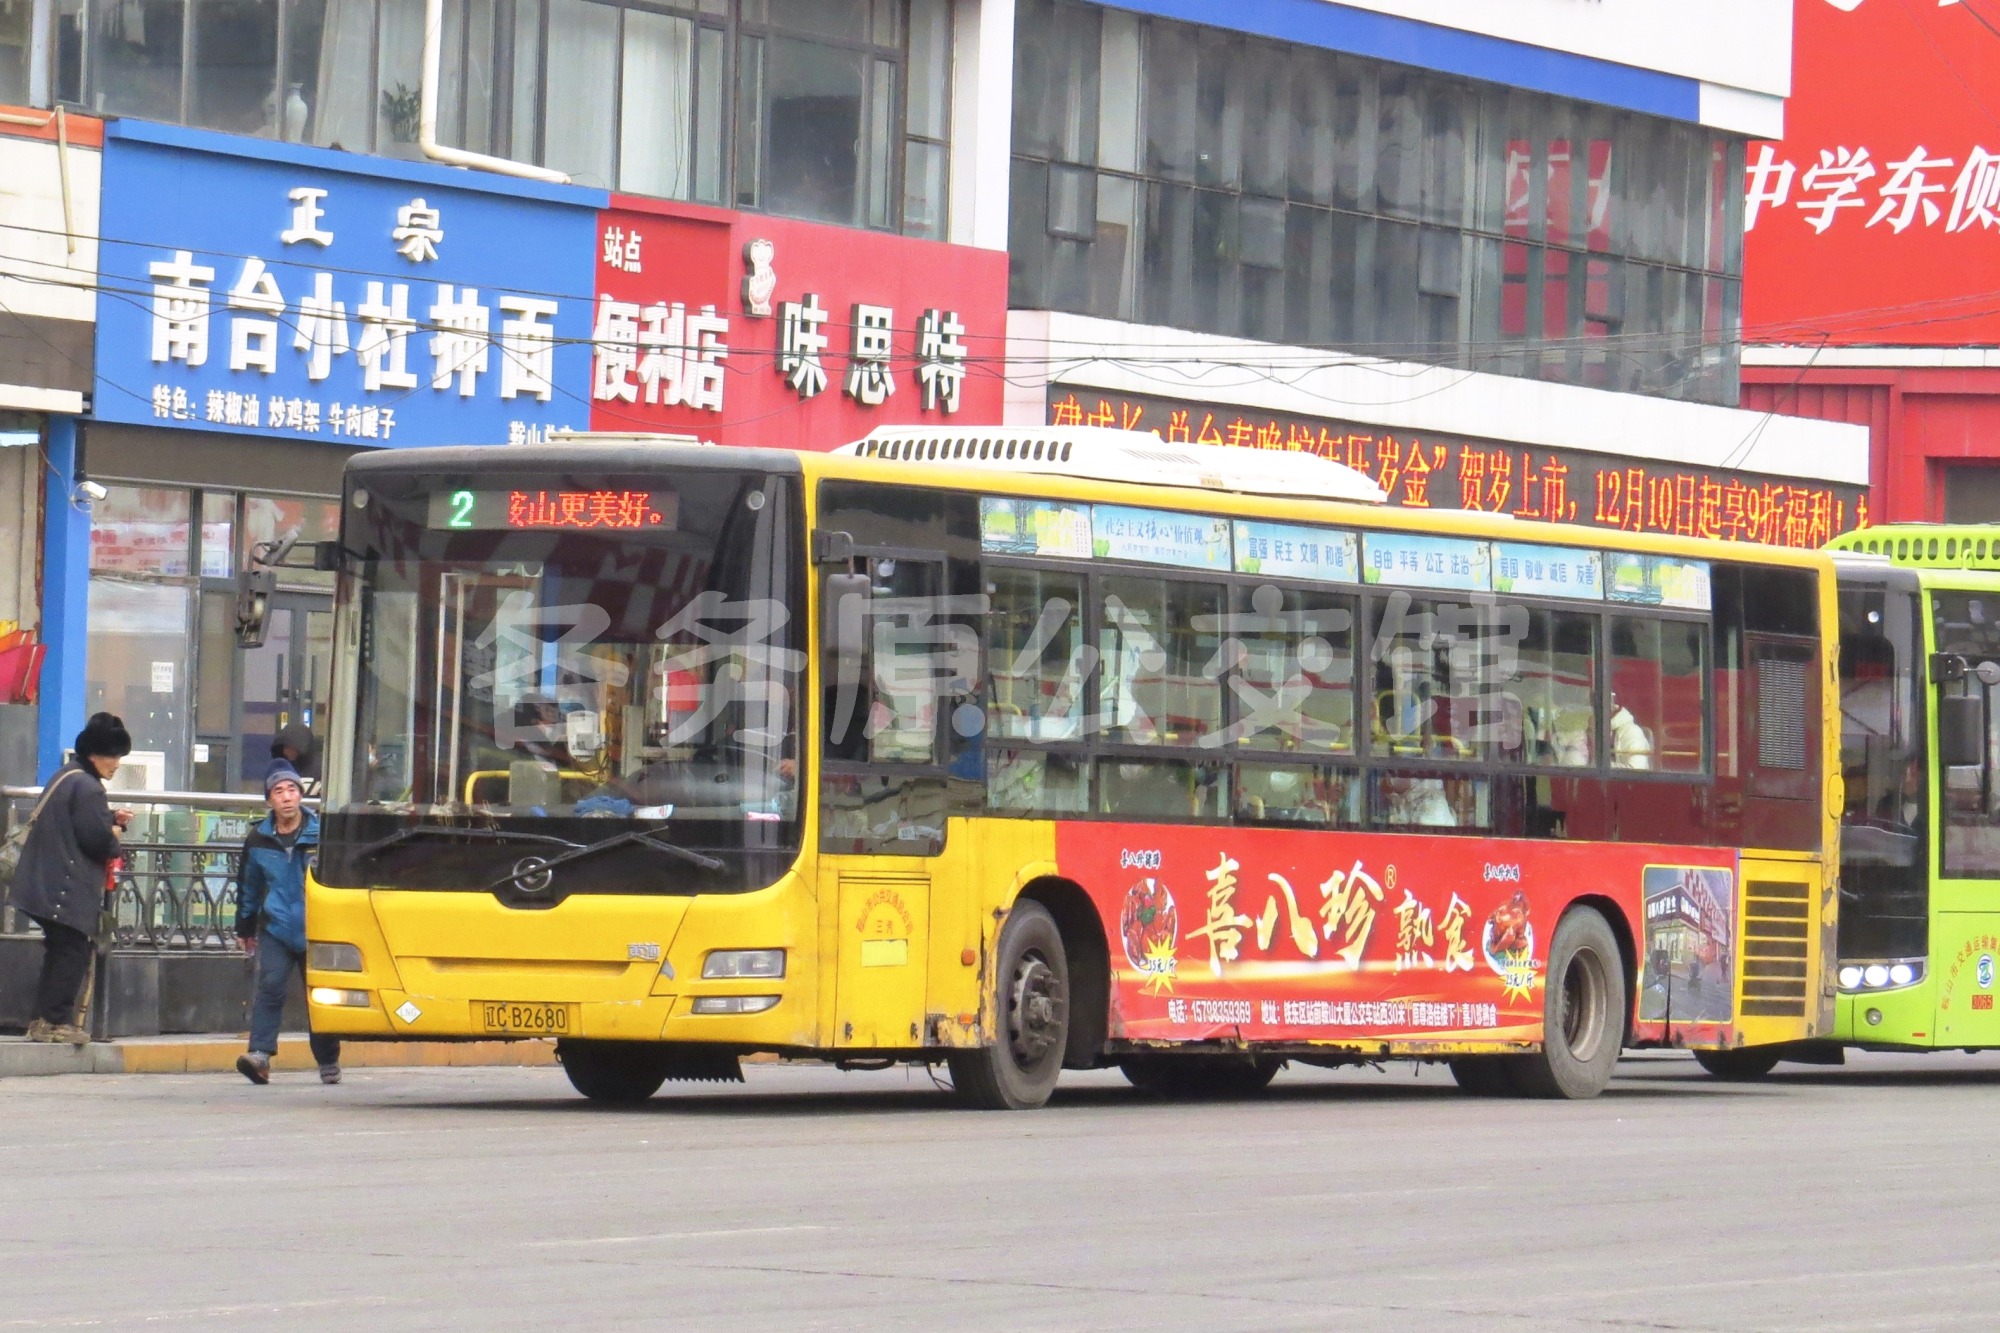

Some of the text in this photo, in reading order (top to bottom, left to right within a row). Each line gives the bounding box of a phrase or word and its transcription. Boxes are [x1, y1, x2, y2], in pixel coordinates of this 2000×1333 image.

[281, 187, 444, 262] 正宗
[603, 226, 642, 274] 站点
[592, 293, 729, 412] 便利店
[776, 292, 968, 415] 味思特
[206, 389, 260, 427] 辣椒油
[268, 396, 321, 433] 炒鸡架
[450, 491, 474, 527] 2
[1249, 537, 1344, 567] 富强 民主 文明 和谐
[1374, 549, 1470, 575] 自由 平等 公正 法治
[1500, 557, 1594, 586] 爱国 敬业 诚信 友善
